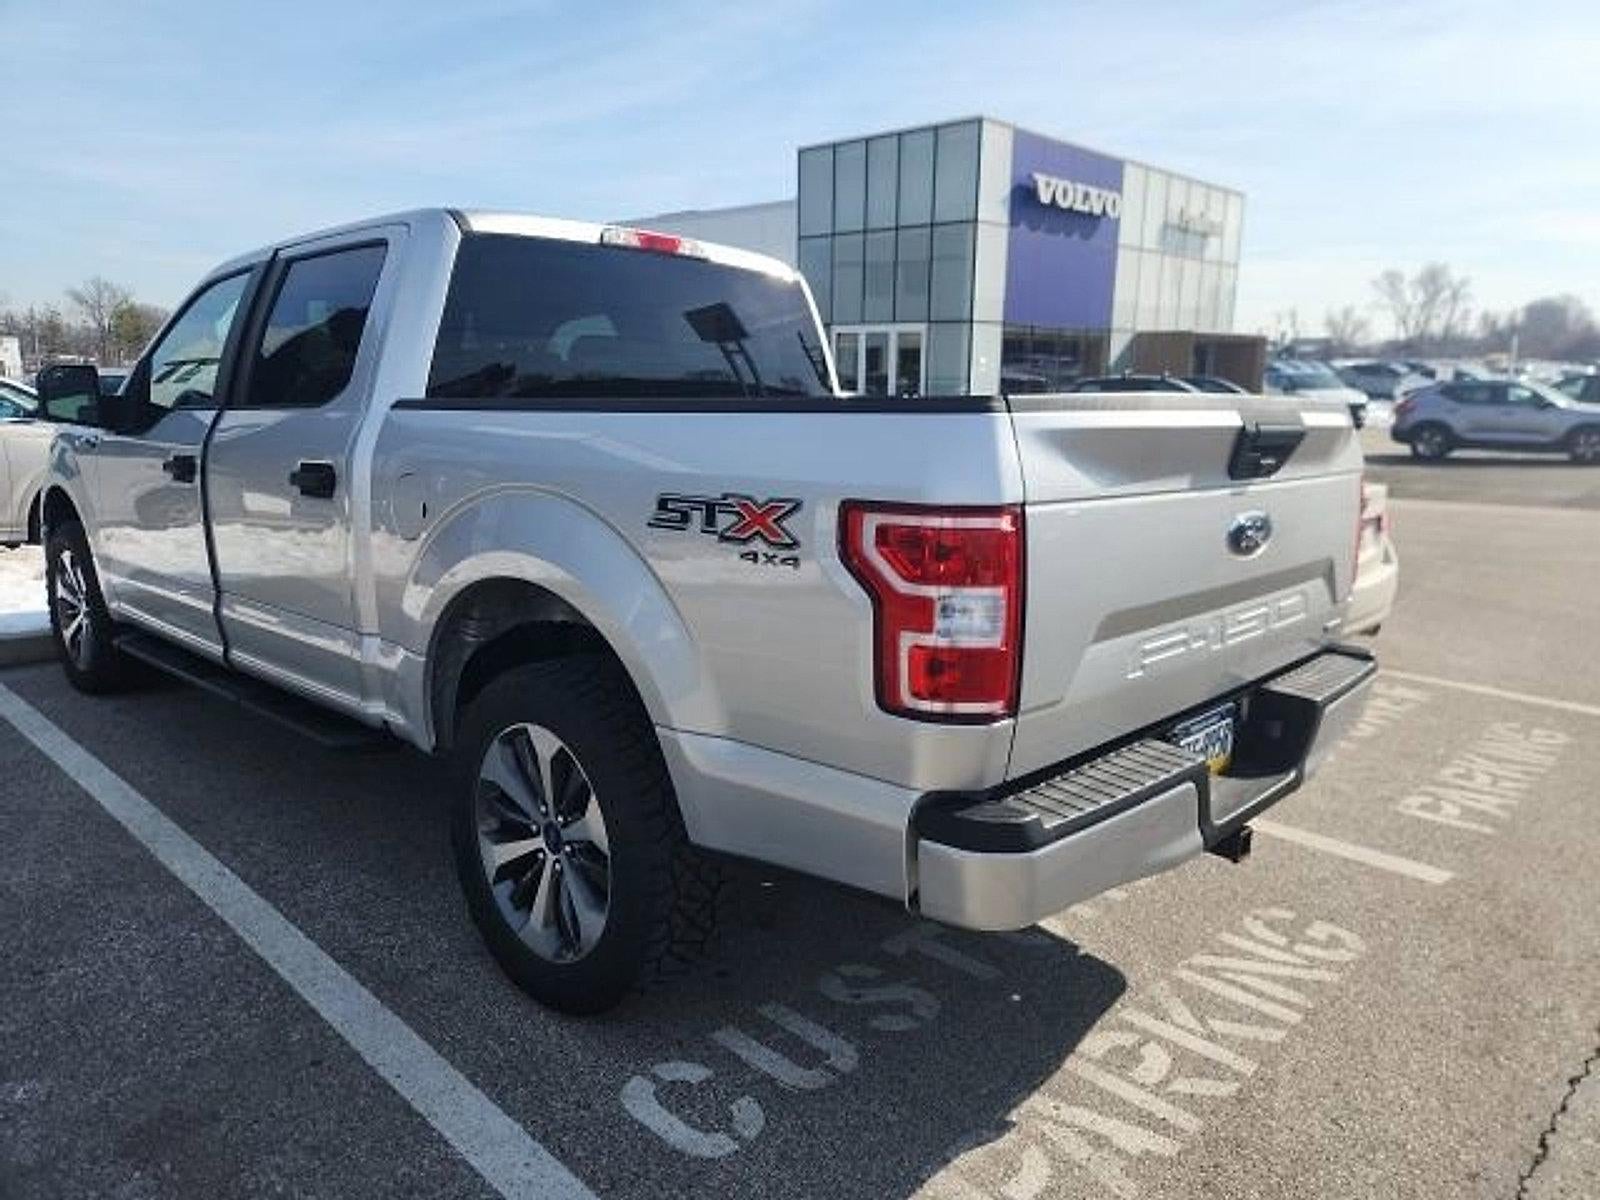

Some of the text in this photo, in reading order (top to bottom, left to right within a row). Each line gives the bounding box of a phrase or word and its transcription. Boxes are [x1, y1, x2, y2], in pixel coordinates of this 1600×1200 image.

[1032, 171, 1121, 220] VOLVO
[646, 492, 803, 550] STX
[1125, 591, 1309, 680] F-150
[620, 922, 1020, 1160] CUST
